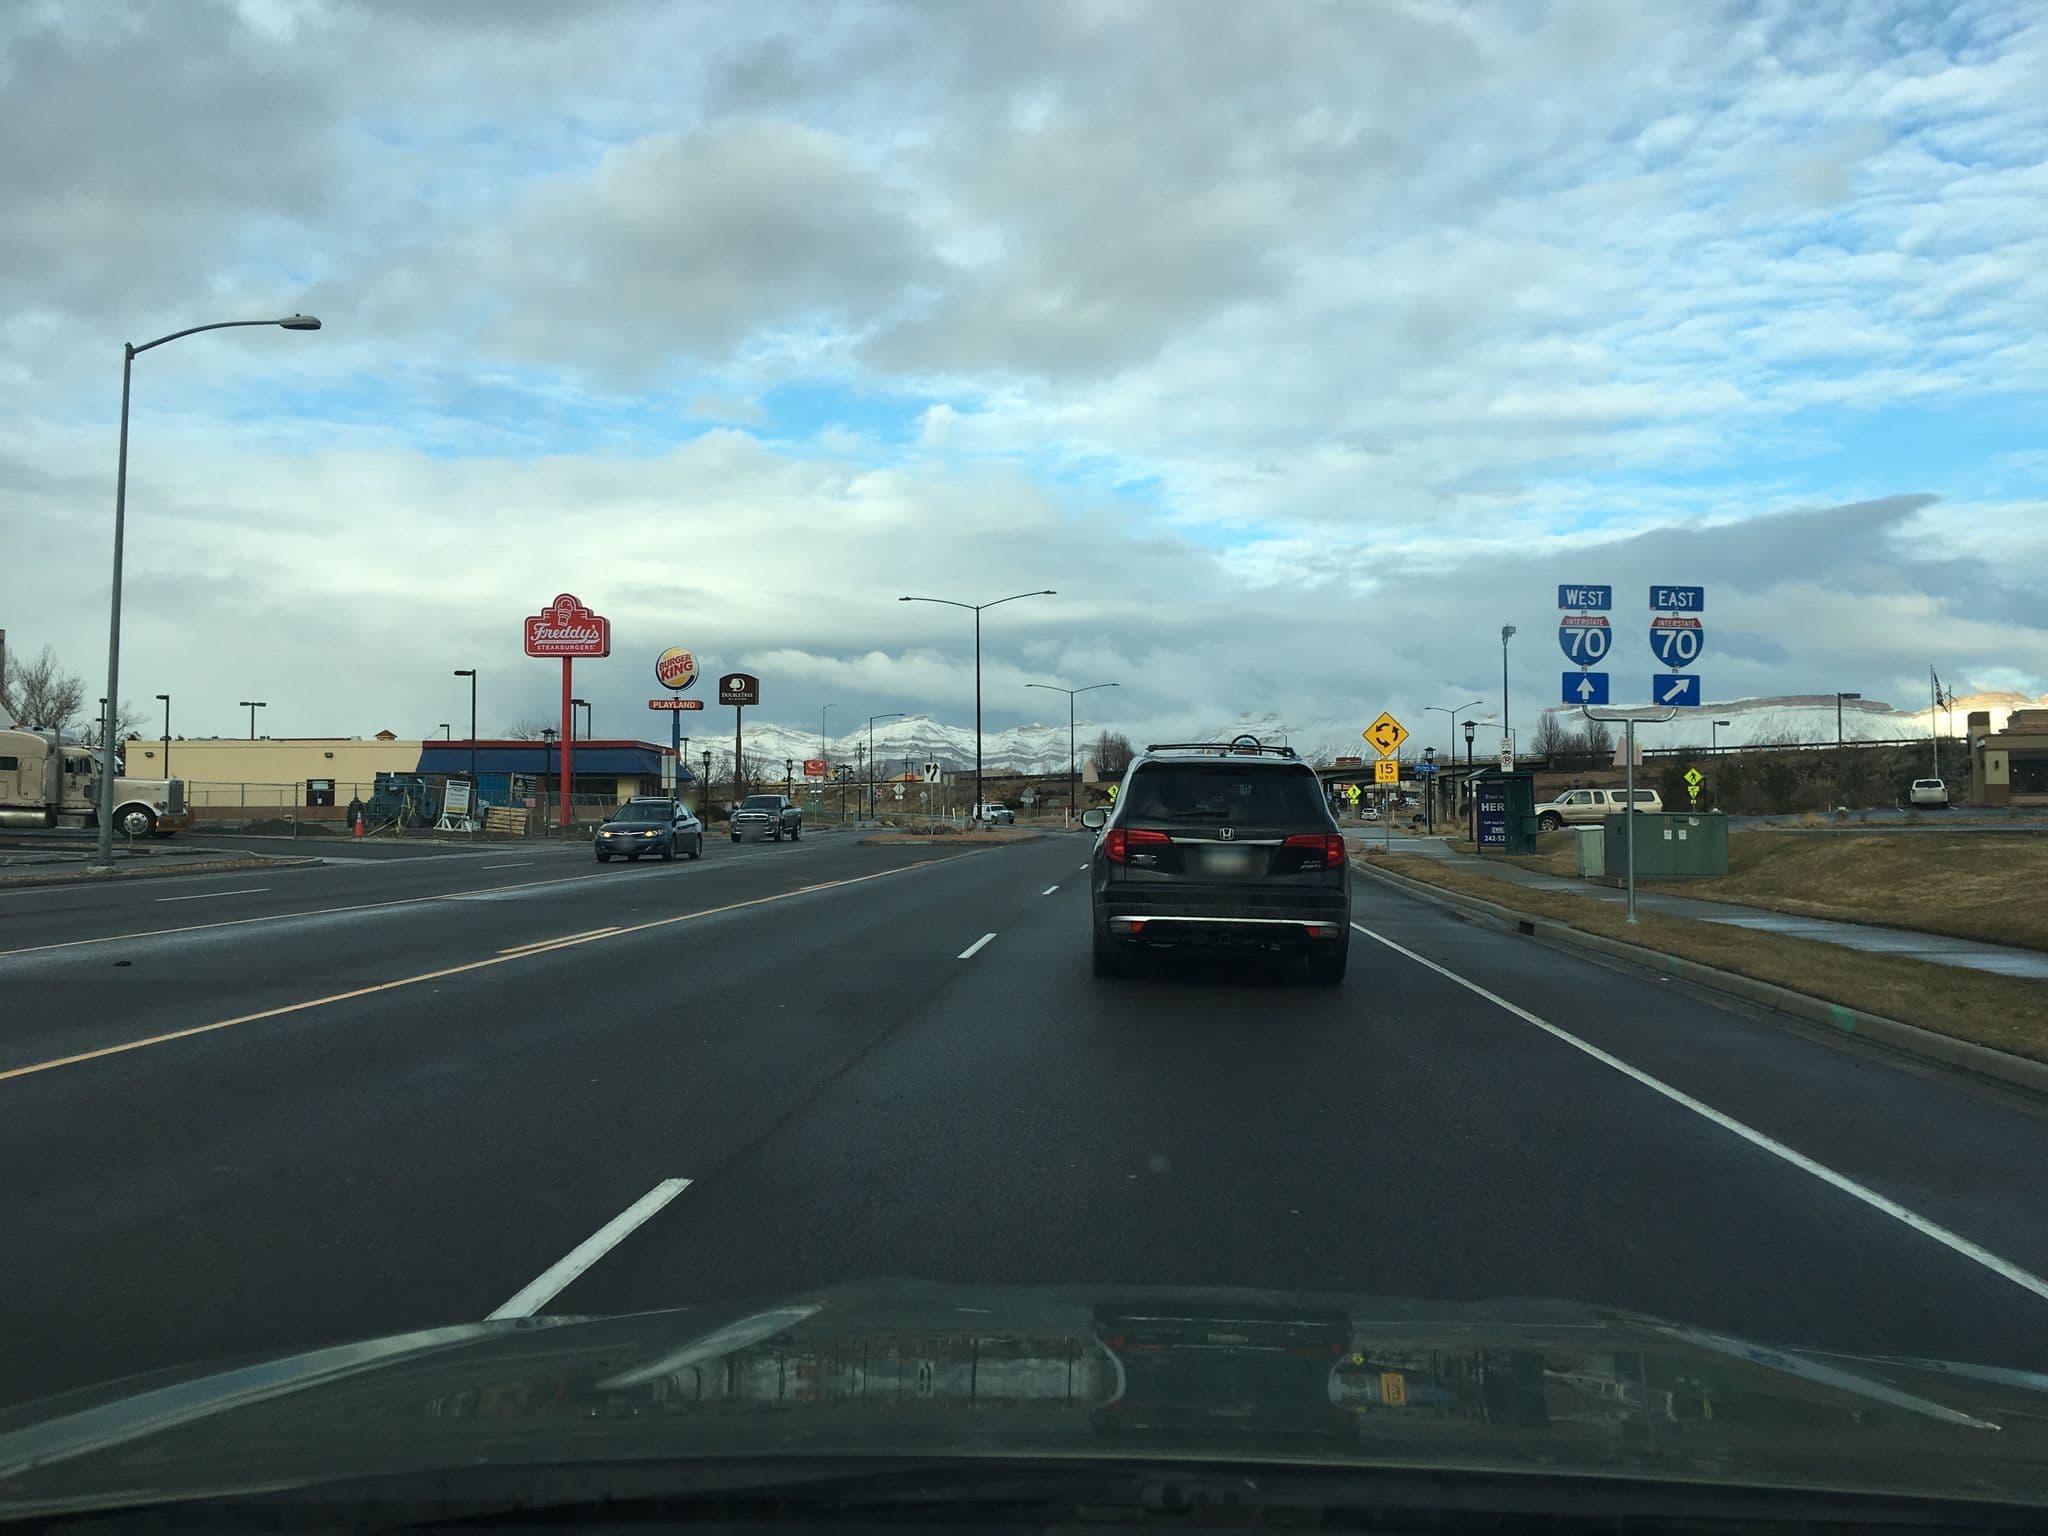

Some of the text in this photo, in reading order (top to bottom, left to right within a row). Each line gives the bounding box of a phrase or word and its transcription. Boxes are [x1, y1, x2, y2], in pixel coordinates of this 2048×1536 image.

[1566, 589, 1604, 606] WEST
[1658, 590, 1695, 607] EAST
[1566, 618, 1604, 626] INTERSTATE
[530, 622, 600, 643] Freddy's
[1565, 628, 1606, 657] 70
[1656, 630, 1697, 659] 70
[659, 653, 692, 671] BURGER
[660, 661, 693, 681] KING
[653, 701, 696, 709] PLAYLAND
[1379, 763, 1394, 774] 15
